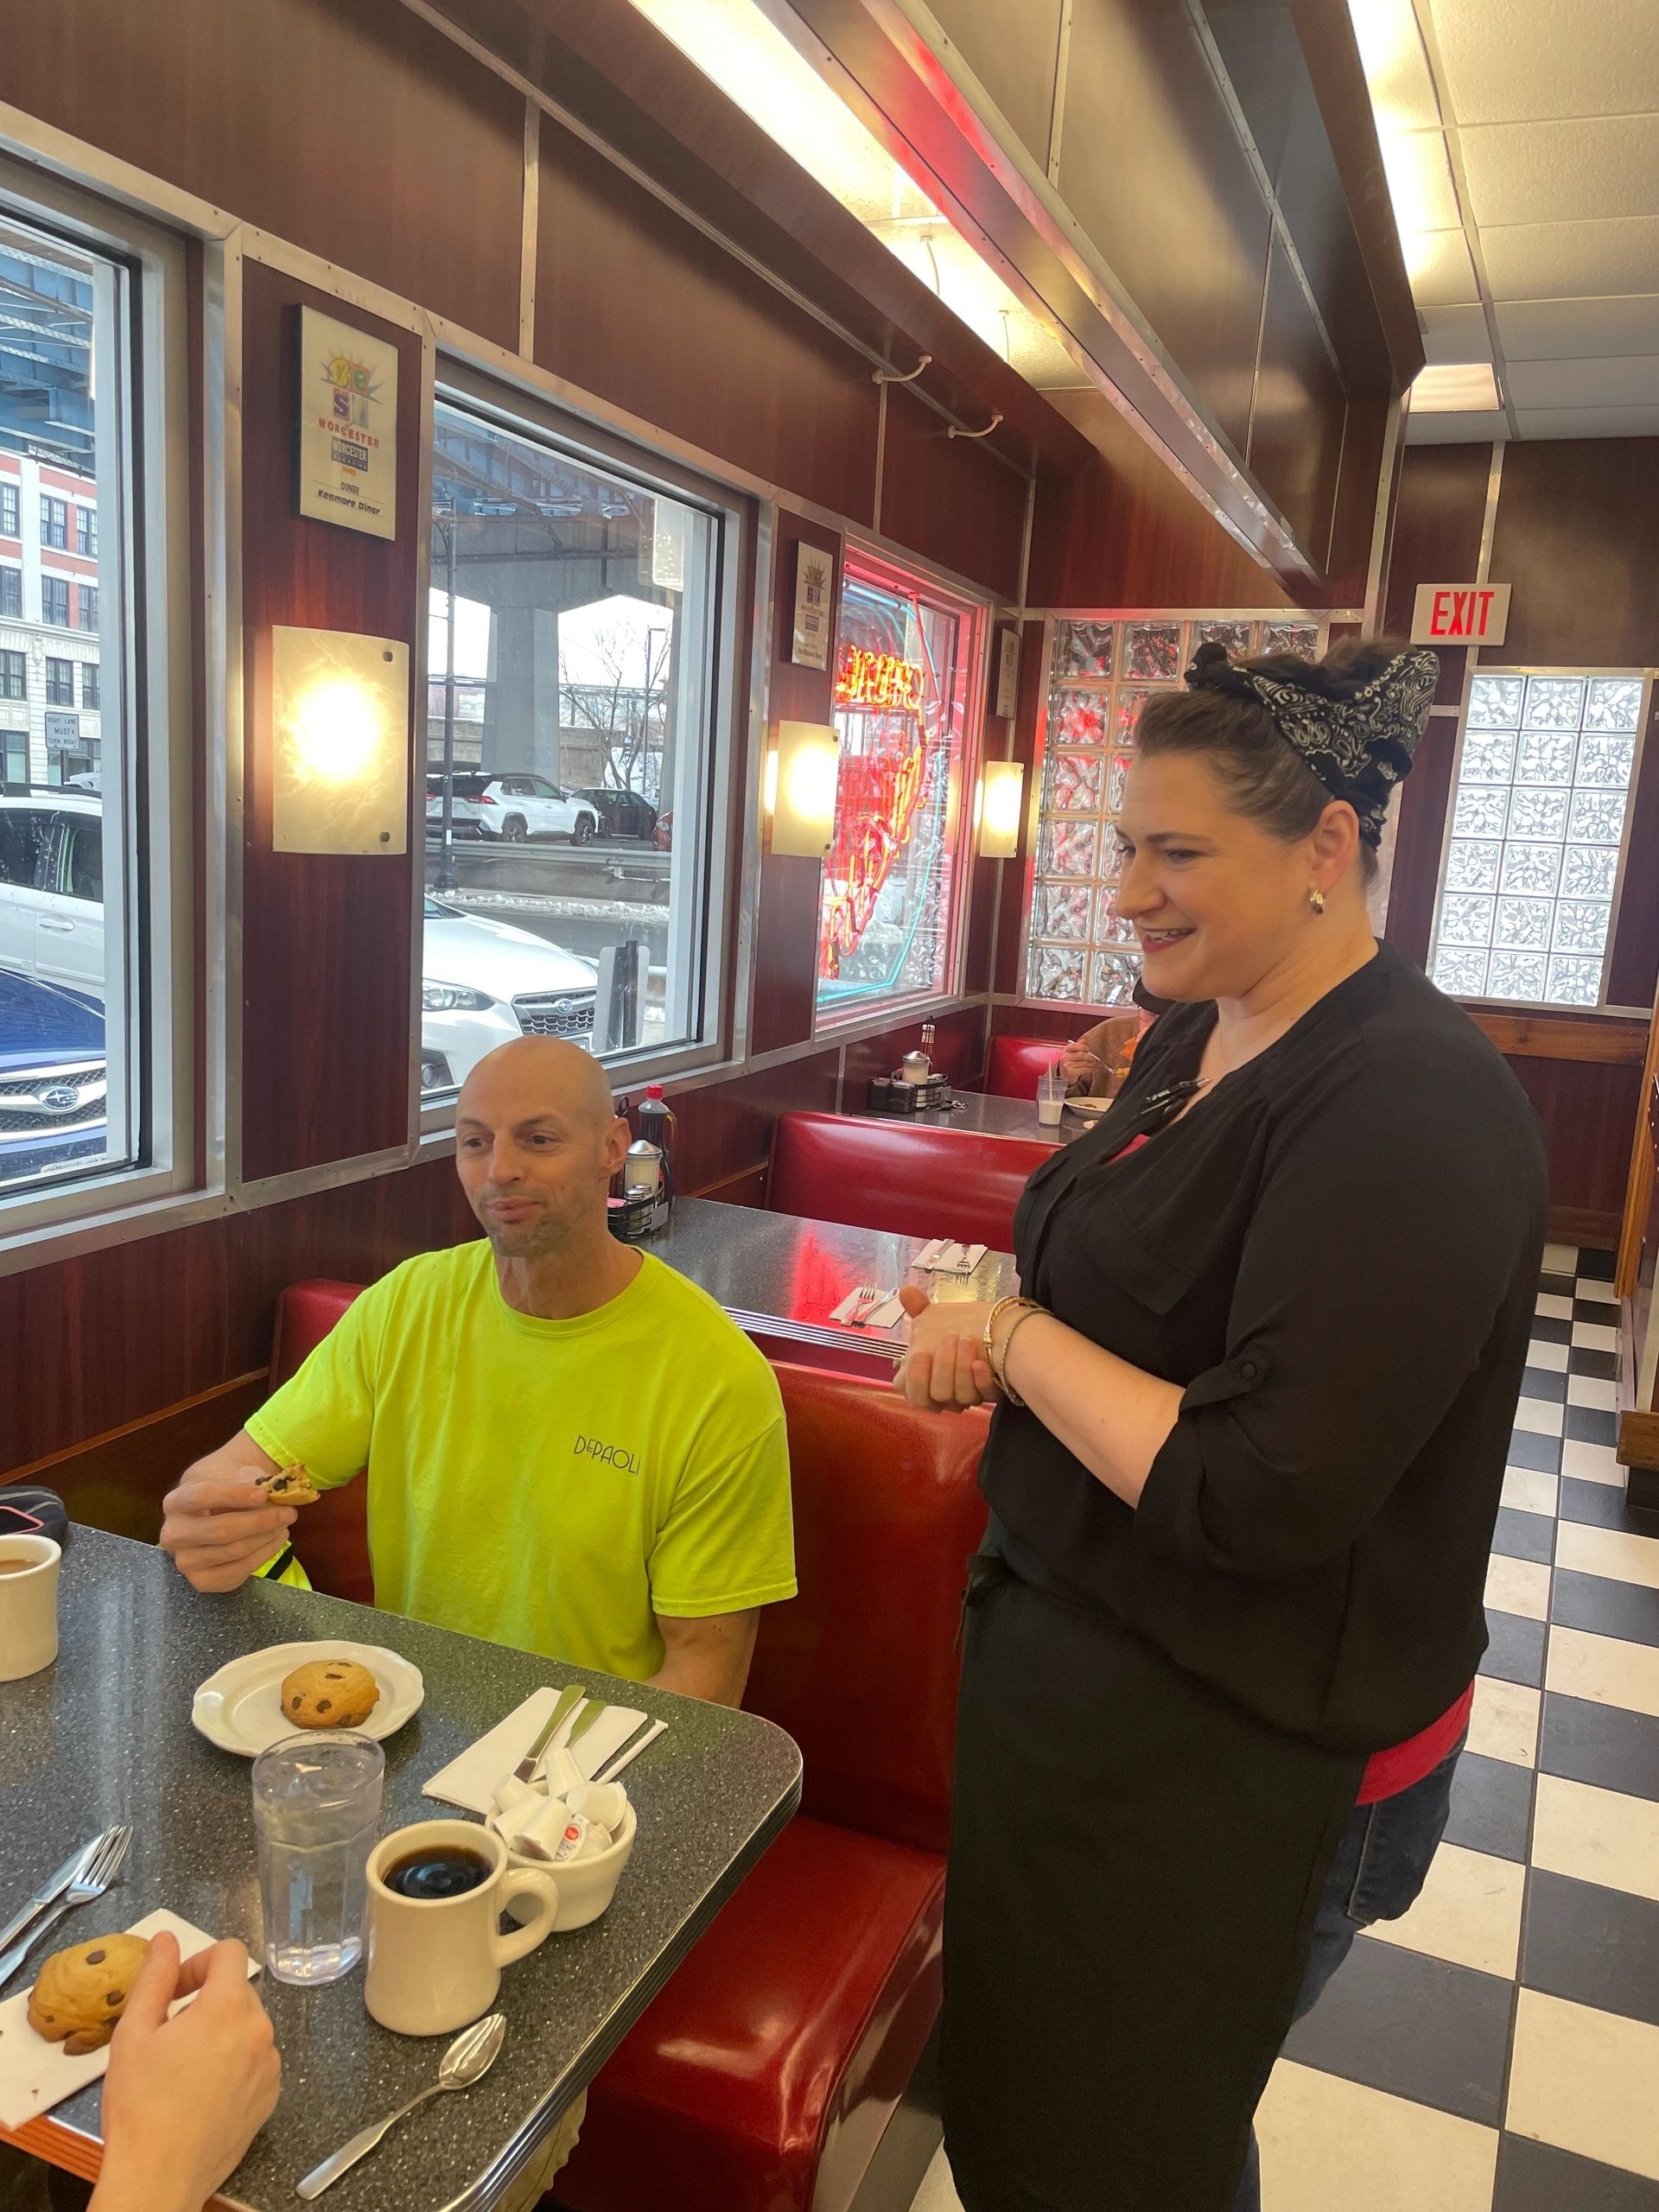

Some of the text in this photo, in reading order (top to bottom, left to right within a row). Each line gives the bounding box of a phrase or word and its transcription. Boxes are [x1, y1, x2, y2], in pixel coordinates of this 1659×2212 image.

[318, 417, 379, 448] WORCESTER
[333, 440, 367, 461] WORCESTER
[340, 481, 359, 494] DINER
[318, 489, 380, 515] Kenmore Diner
[1430, 592, 1495, 636] EXIT
